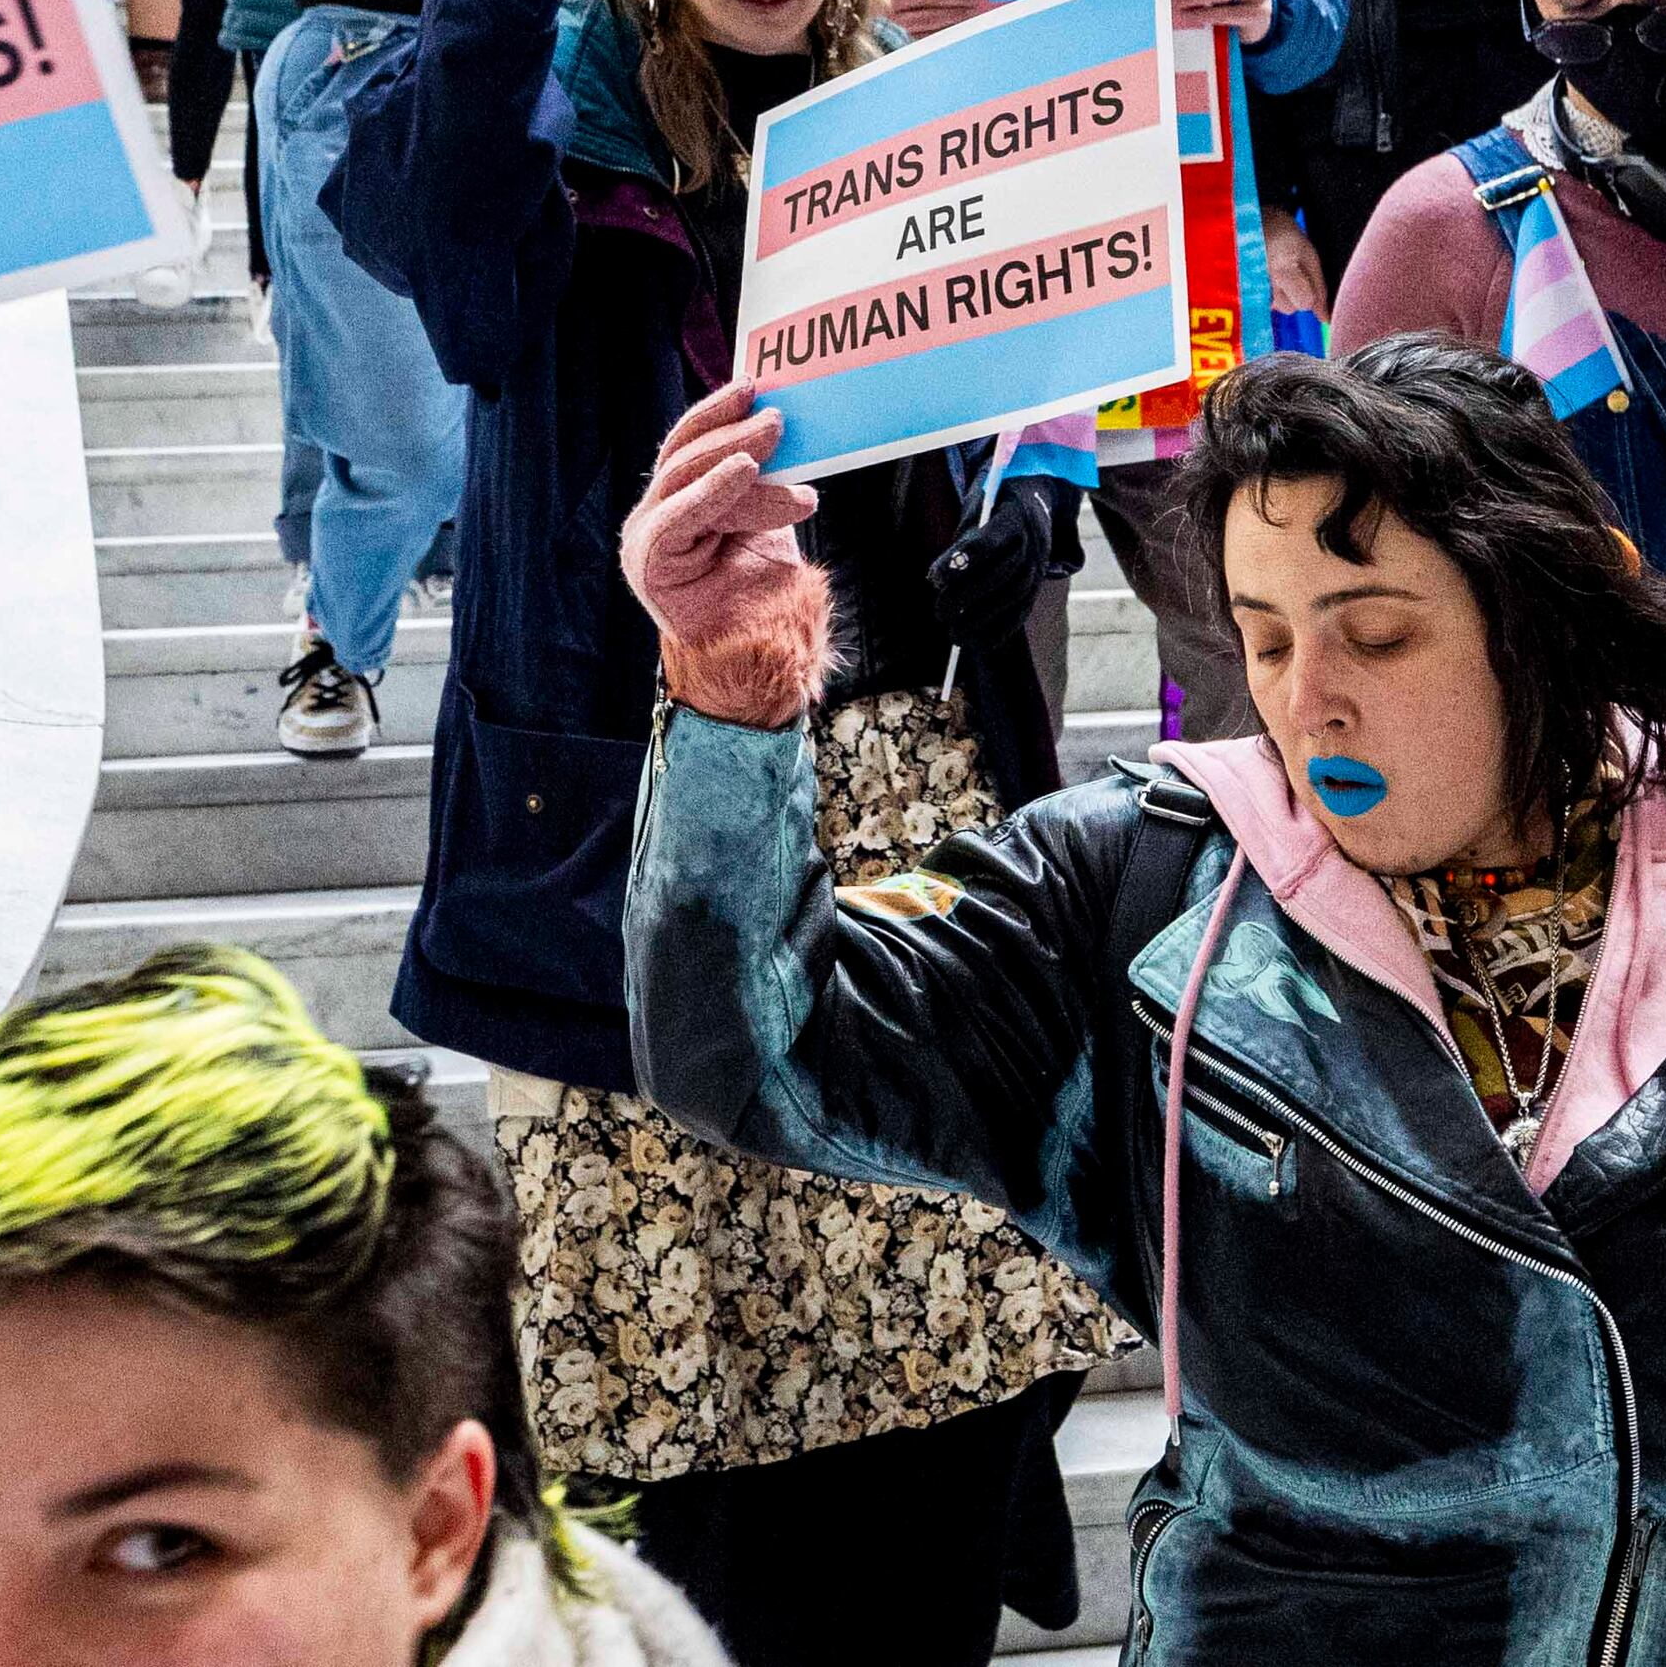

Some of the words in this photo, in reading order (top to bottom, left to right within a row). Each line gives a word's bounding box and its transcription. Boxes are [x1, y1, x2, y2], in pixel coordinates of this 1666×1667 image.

[784, 143, 925, 234] TRANS
[939, 79, 1125, 176] RIGHTS
[896, 195, 986, 261] ARE
[755, 285, 931, 379] HUMAN
[945, 225, 1153, 324] RIGHTS!
